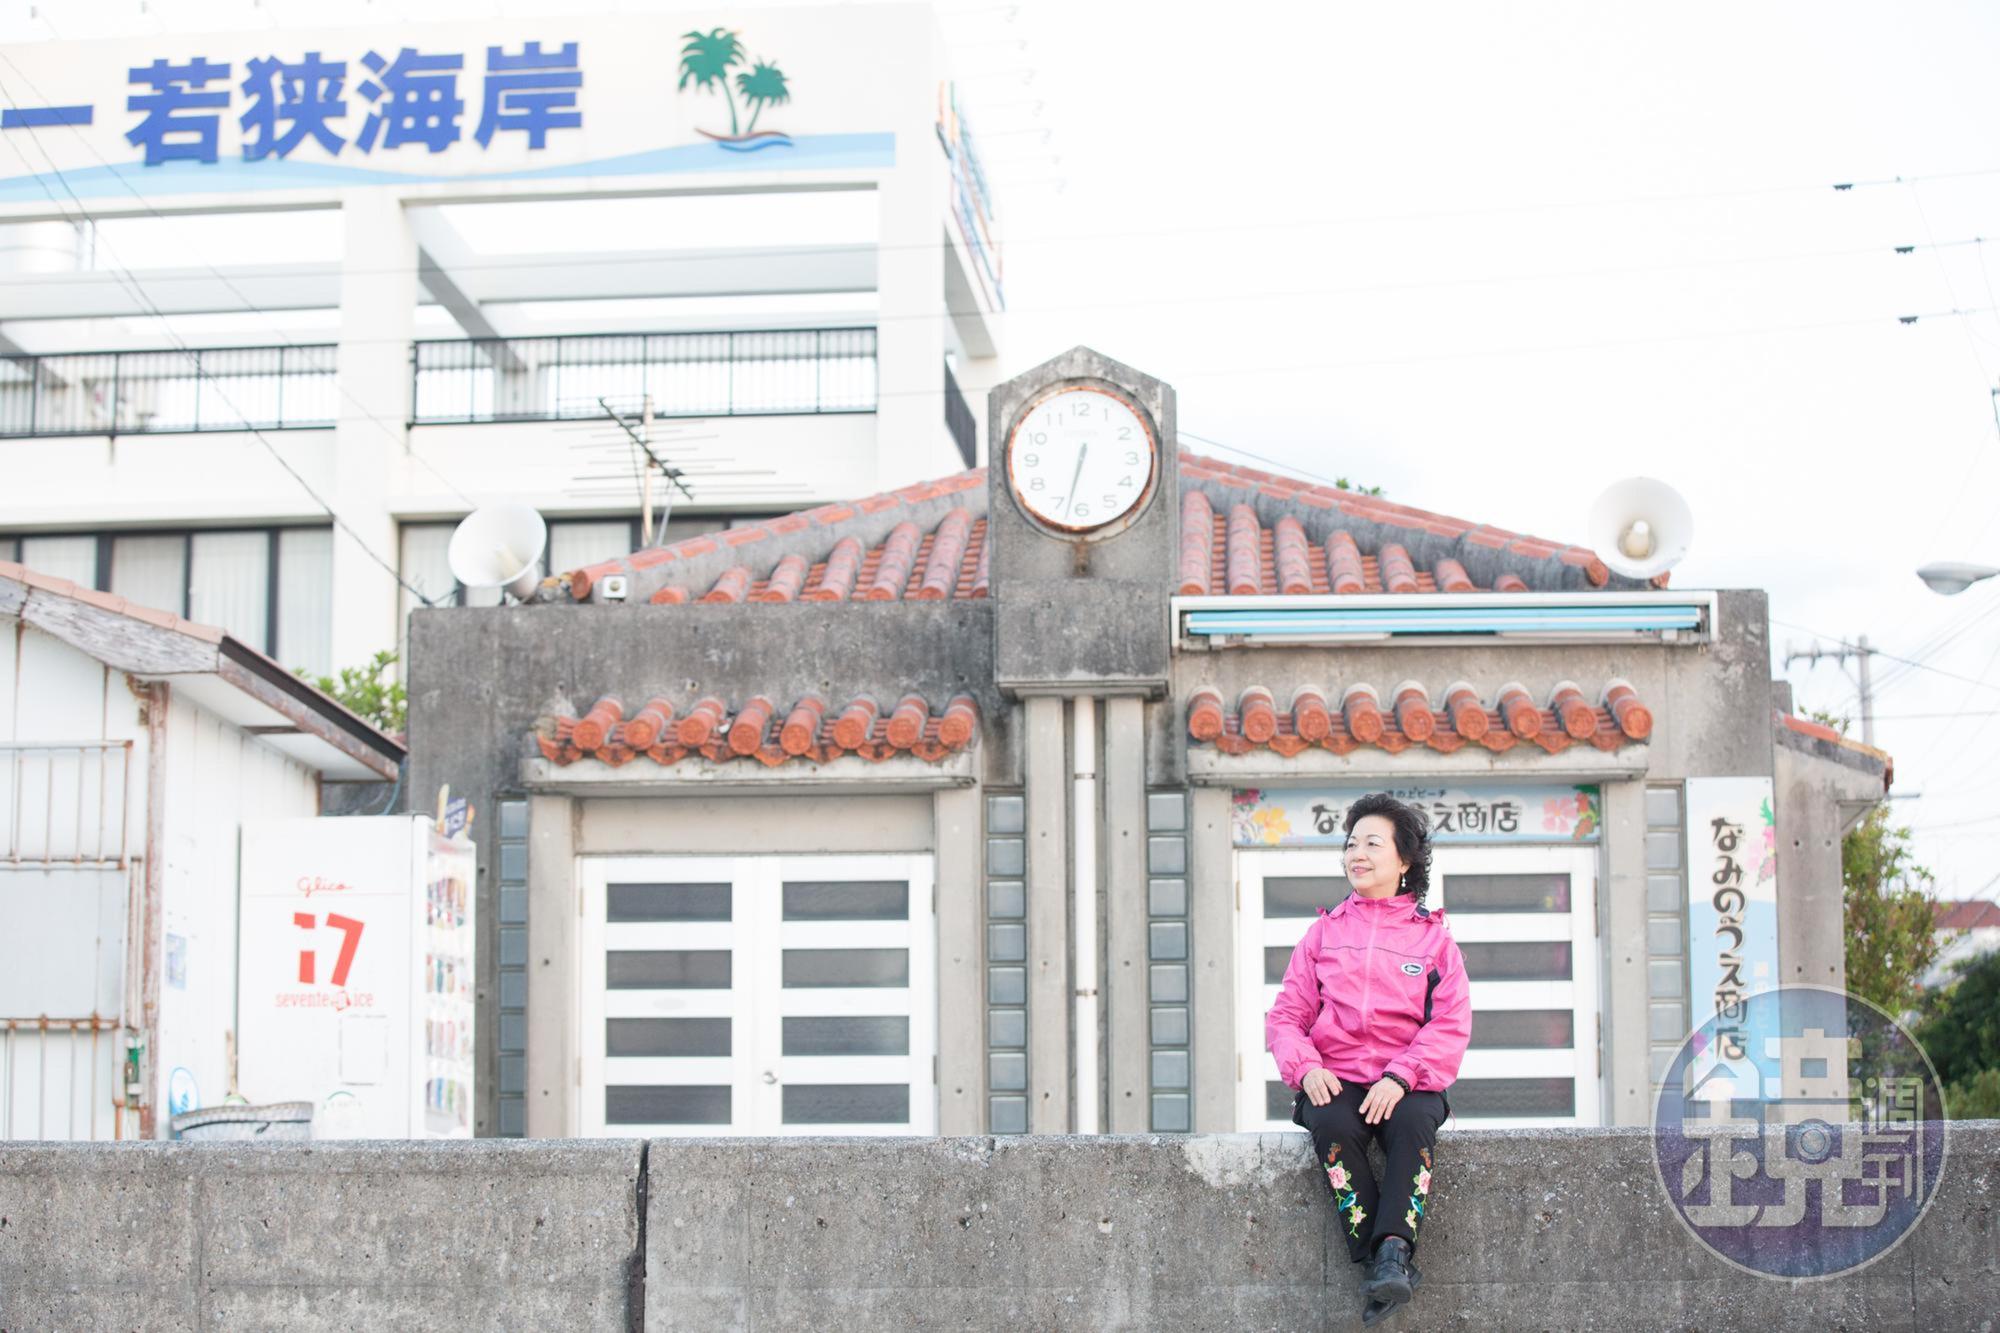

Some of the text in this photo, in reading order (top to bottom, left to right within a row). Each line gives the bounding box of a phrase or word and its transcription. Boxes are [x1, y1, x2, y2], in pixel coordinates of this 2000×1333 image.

[1072, 402, 1090, 417] 12
[1047, 413, 1063, 426] 11
[1029, 432, 1047, 445] 10
[1117, 426, 1131, 440] 2
[1024, 453, 1039, 467] 9
[1125, 452, 1139, 466] 3
[1030, 477, 1045, 491] 8
[1117, 475, 1132, 488] 4
[1050, 496, 1065, 509] 7
[1103, 495, 1117, 508] 5
[1074, 503, 1089, 517] 6
[297, 876, 353, 898] Glico
[1711, 817, 1748, 1060] なみのうえ商店
